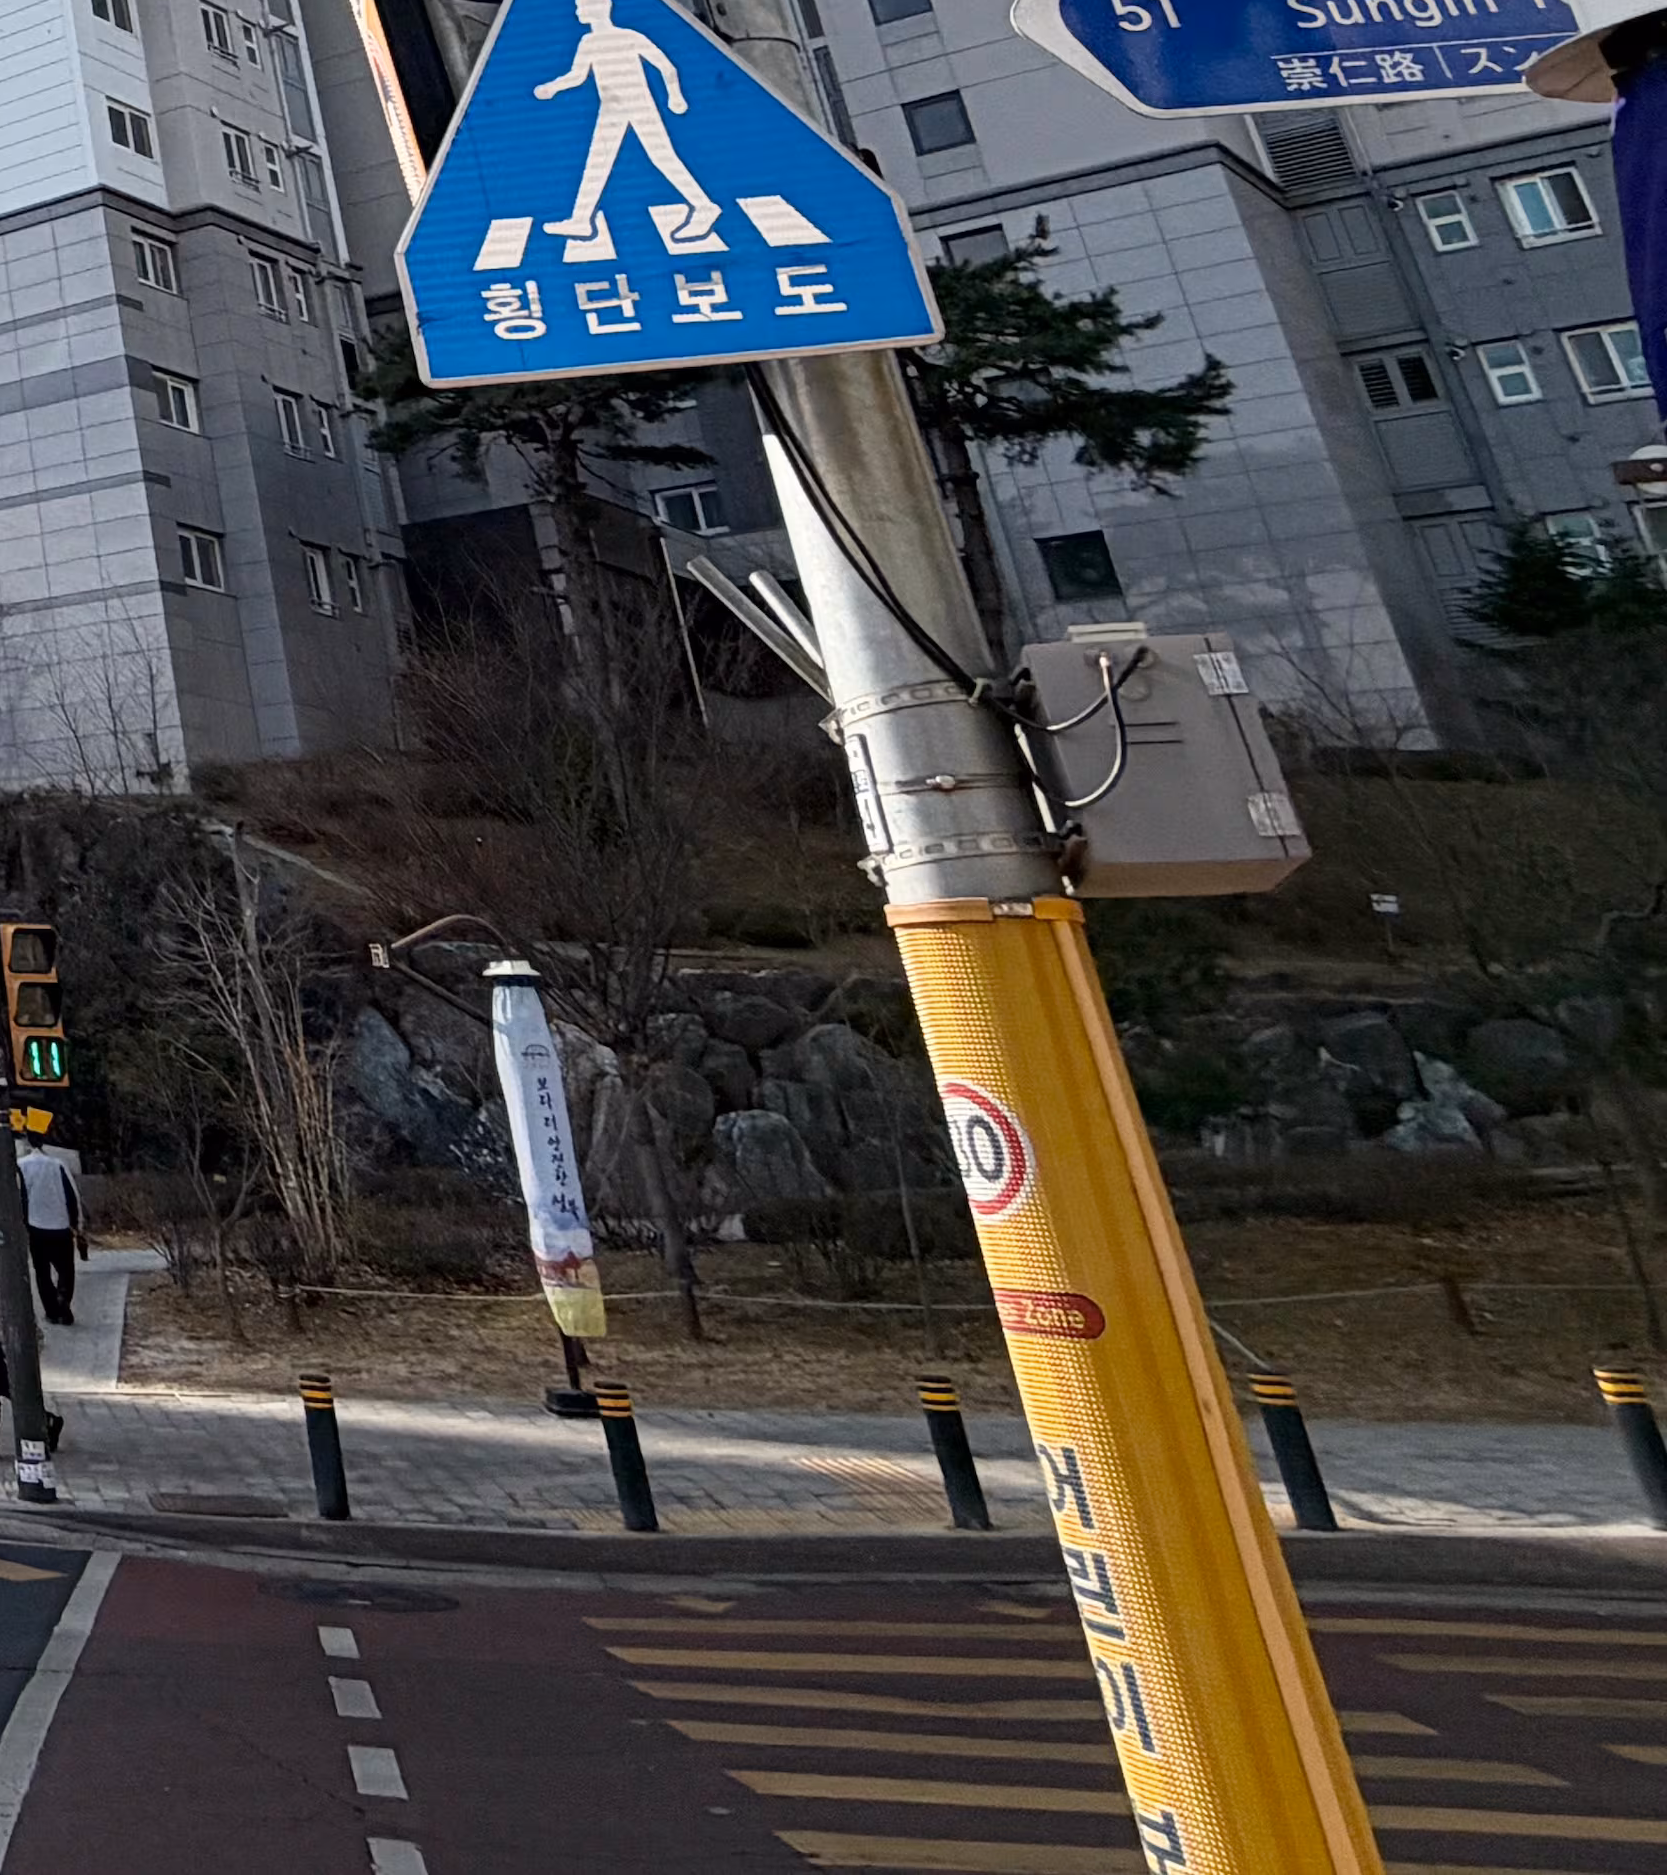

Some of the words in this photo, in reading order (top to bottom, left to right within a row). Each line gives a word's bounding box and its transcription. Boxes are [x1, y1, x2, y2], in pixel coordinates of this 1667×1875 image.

[1277, 52, 1427, 93] 崇仁路
[480, 263, 848, 340] 횡단보도
